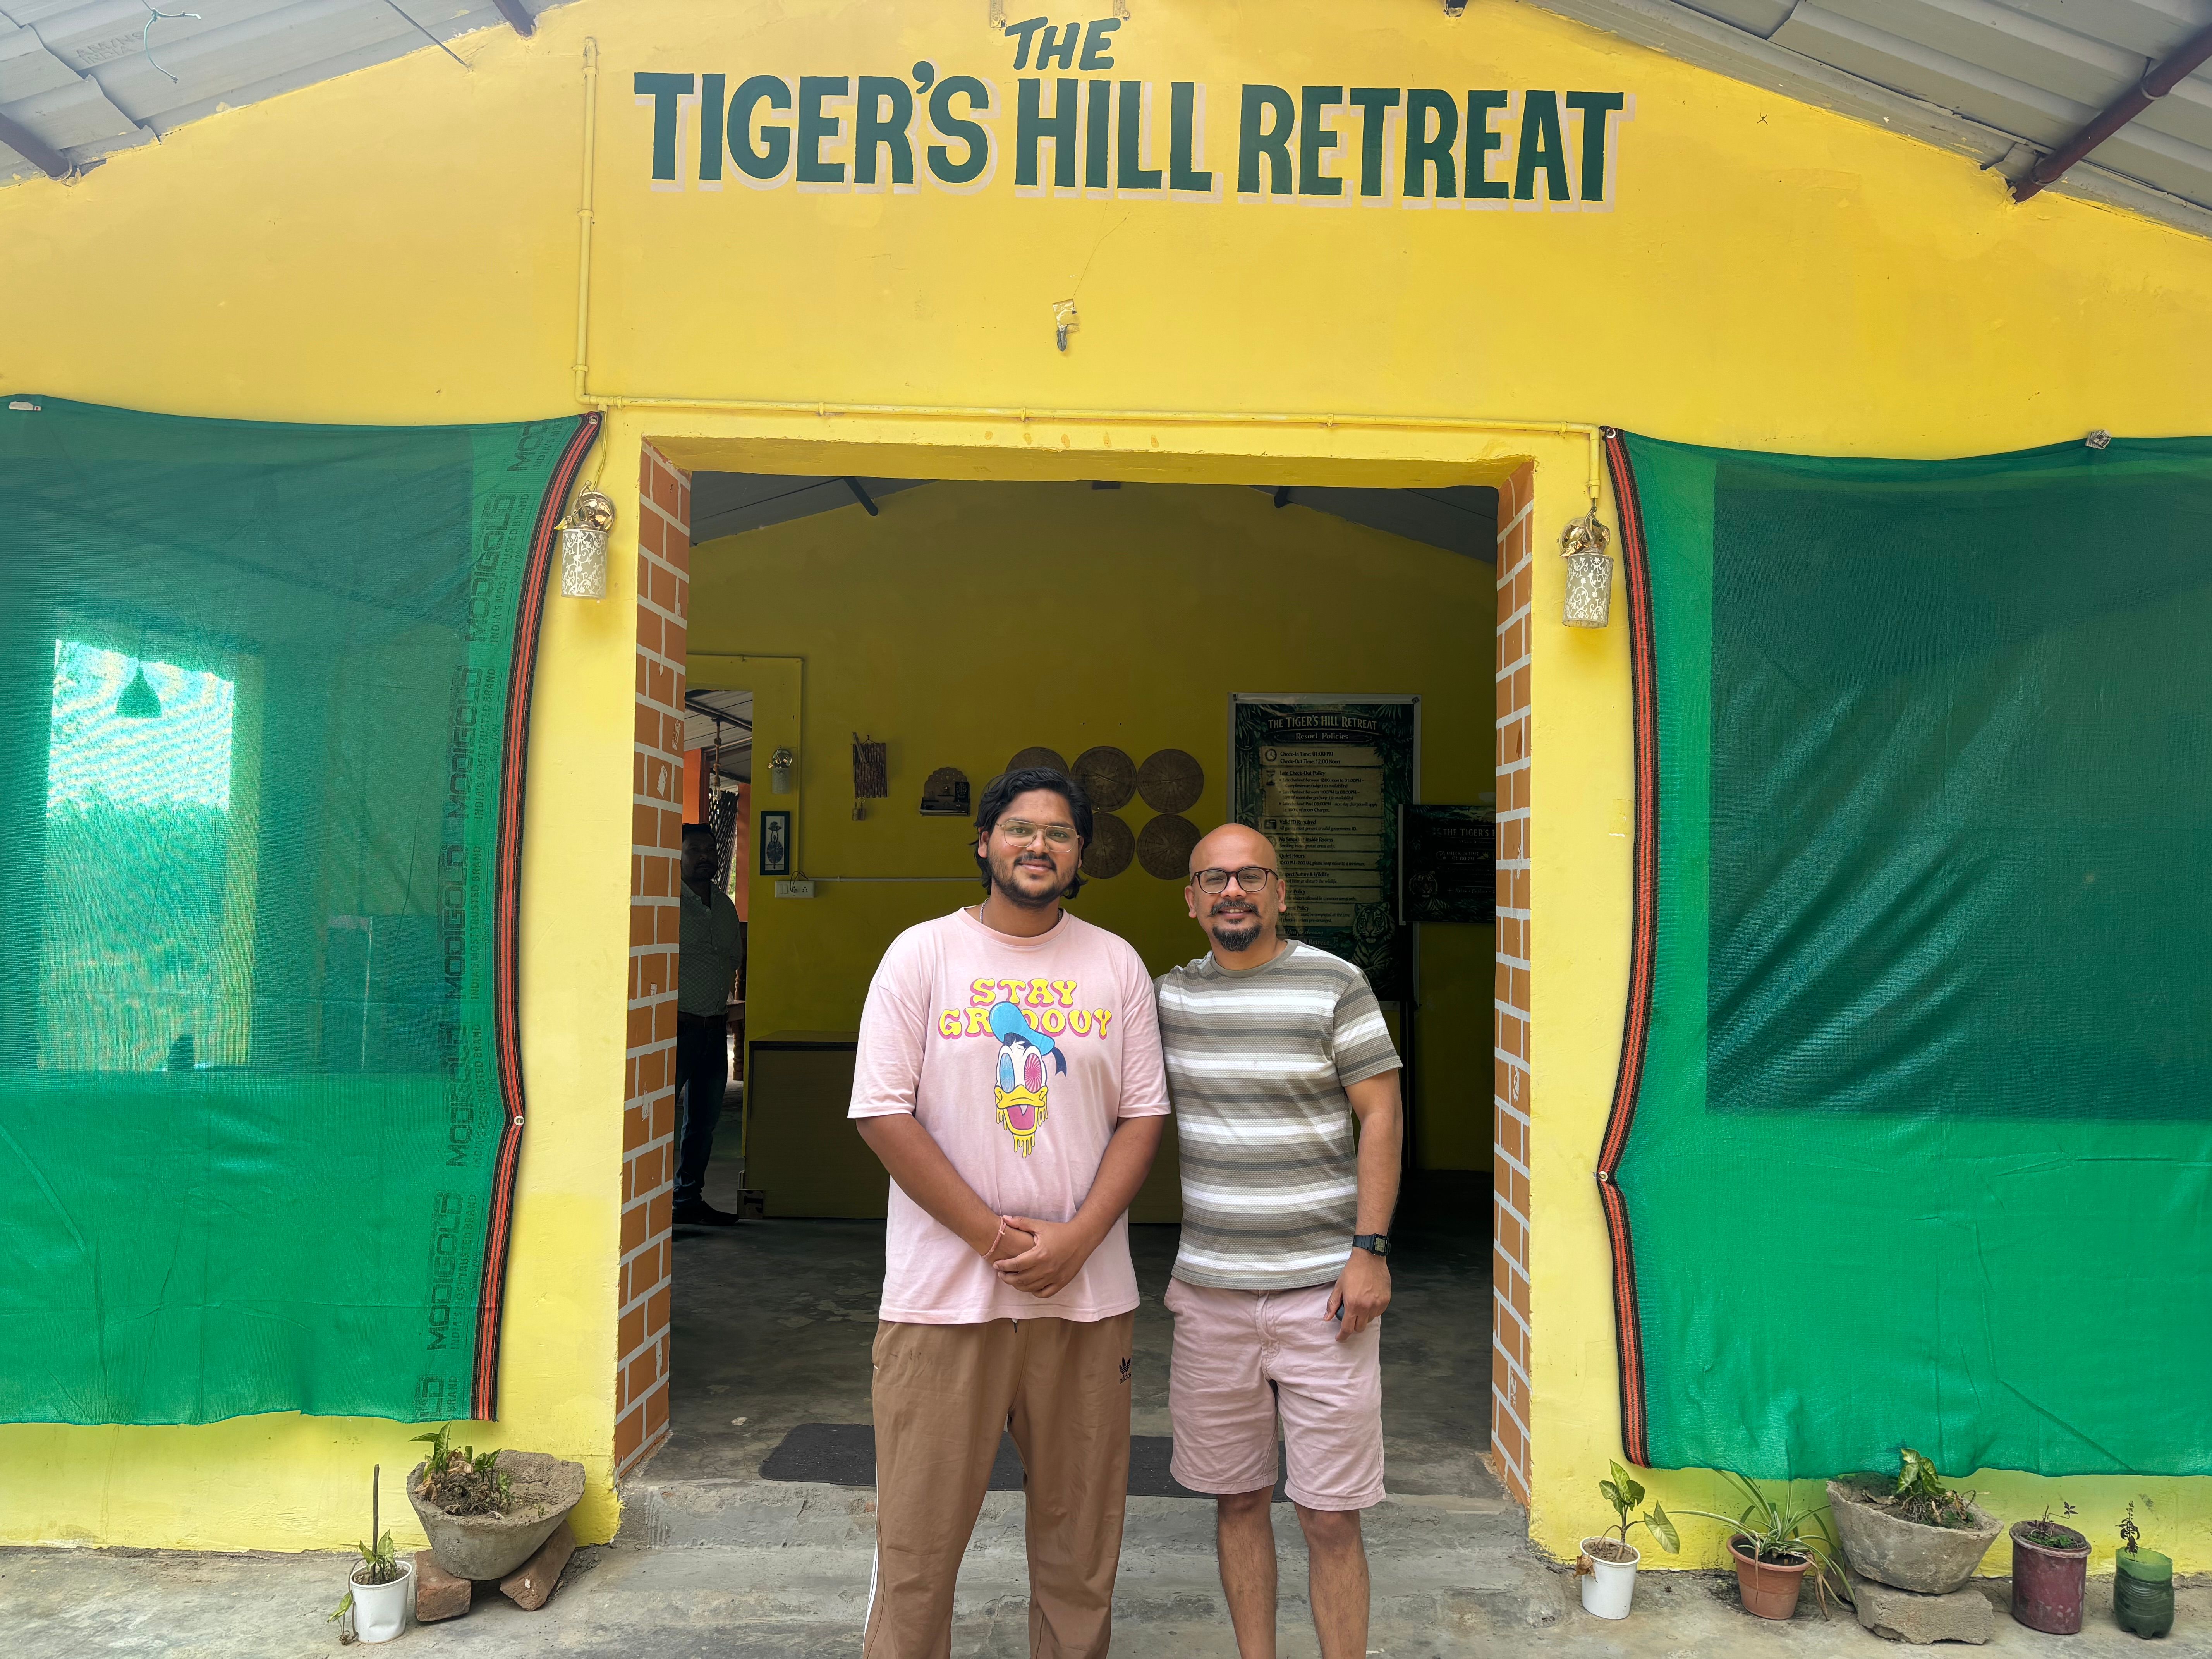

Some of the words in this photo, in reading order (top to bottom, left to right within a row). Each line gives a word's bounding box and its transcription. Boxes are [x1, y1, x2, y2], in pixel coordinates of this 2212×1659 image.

[82, 45, 137, 65] INDIA
[1005, 16, 1121, 70] THE
[634, 61, 989, 184] TIGER'S
[1014, 78, 1213, 192] HILL
[1237, 83, 1624, 201] RETREAT
[512, 494, 529, 526] BRAND
[465, 494, 516, 642] MODIGOLD
[483, 668, 496, 702] BRAND
[1267, 719, 1283, 729] THE
[1285, 715, 1319, 728] TIGER'S
[1321, 716, 1339, 726] HILL
[1341, 716, 1377, 730] RETREAT
[448, 667, 483, 818] MODIGOLD
[1460, 828, 1489, 836] TIGER'S
[970, 978, 1077, 1008] STAY
[938, 1007, 1112, 1040] GROOVY
[464, 1194, 476, 1230] BRAND
[427, 1192, 463, 1350] MODIGOLD
[447, 1376, 457, 1412] BRAND
